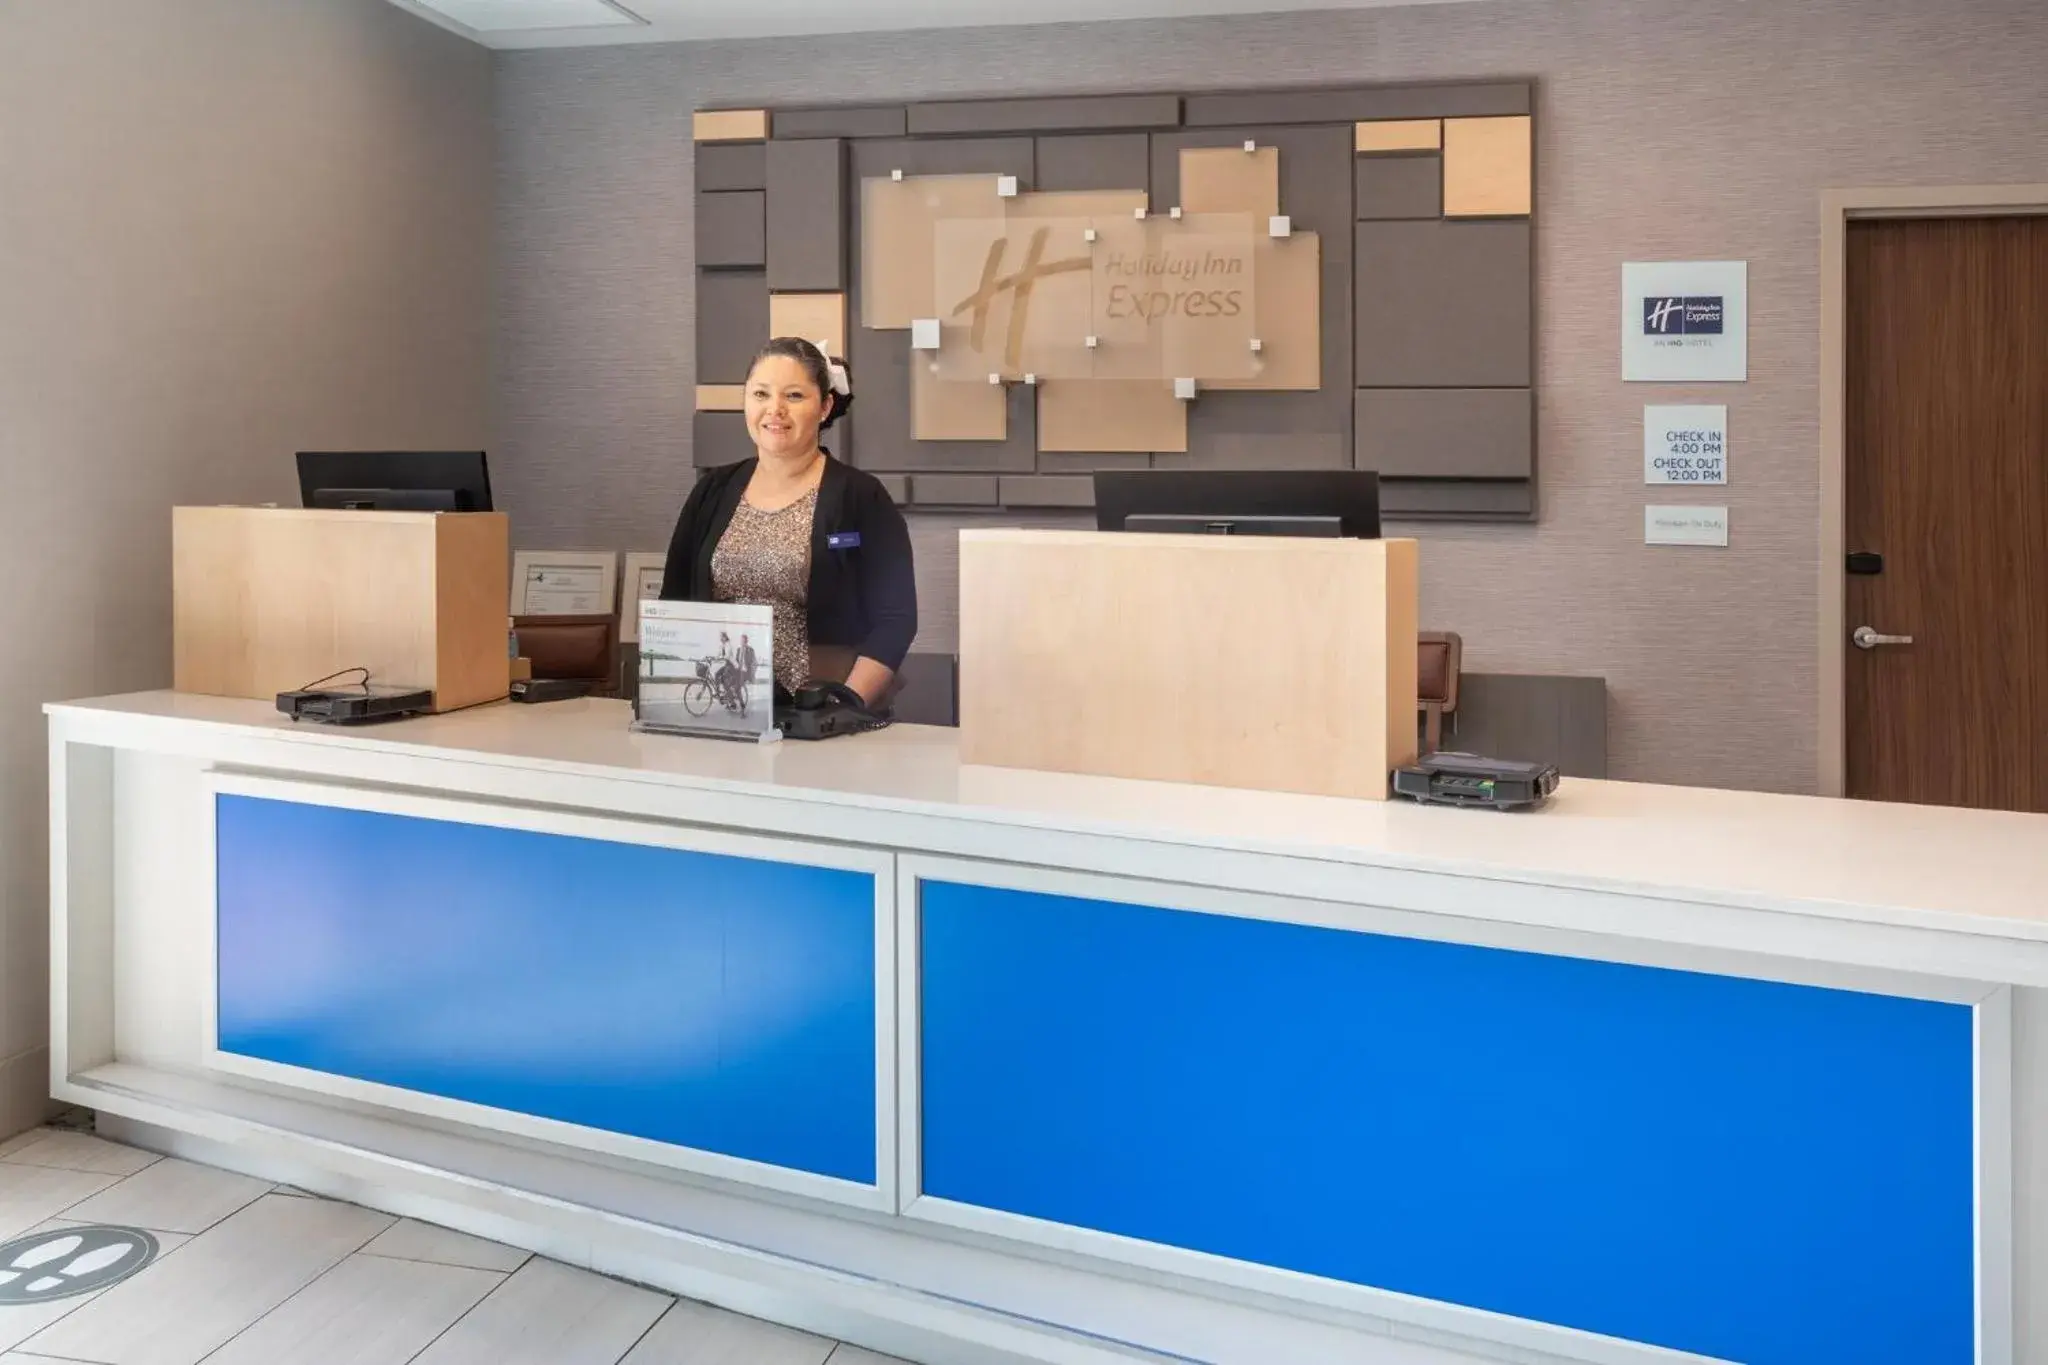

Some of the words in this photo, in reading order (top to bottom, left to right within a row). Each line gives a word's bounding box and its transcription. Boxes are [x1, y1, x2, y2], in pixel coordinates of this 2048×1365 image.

[1105, 251, 1198, 281] Holiday
[1203, 251, 1242, 274] Inn
[1106, 284, 1243, 326] Express
[1686, 312, 1721, 323] Express
[1666, 431, 1704, 442] CHECK
[1708, 431, 1721, 442] IN
[1670, 443, 1699, 454] 4:00
[1703, 443, 1721, 454] PM
[1654, 458, 1692, 469] CHECK
[1696, 458, 1721, 469] OUT
[1667, 470, 1699, 481] 12:00
[1703, 470, 1721, 481] PM
